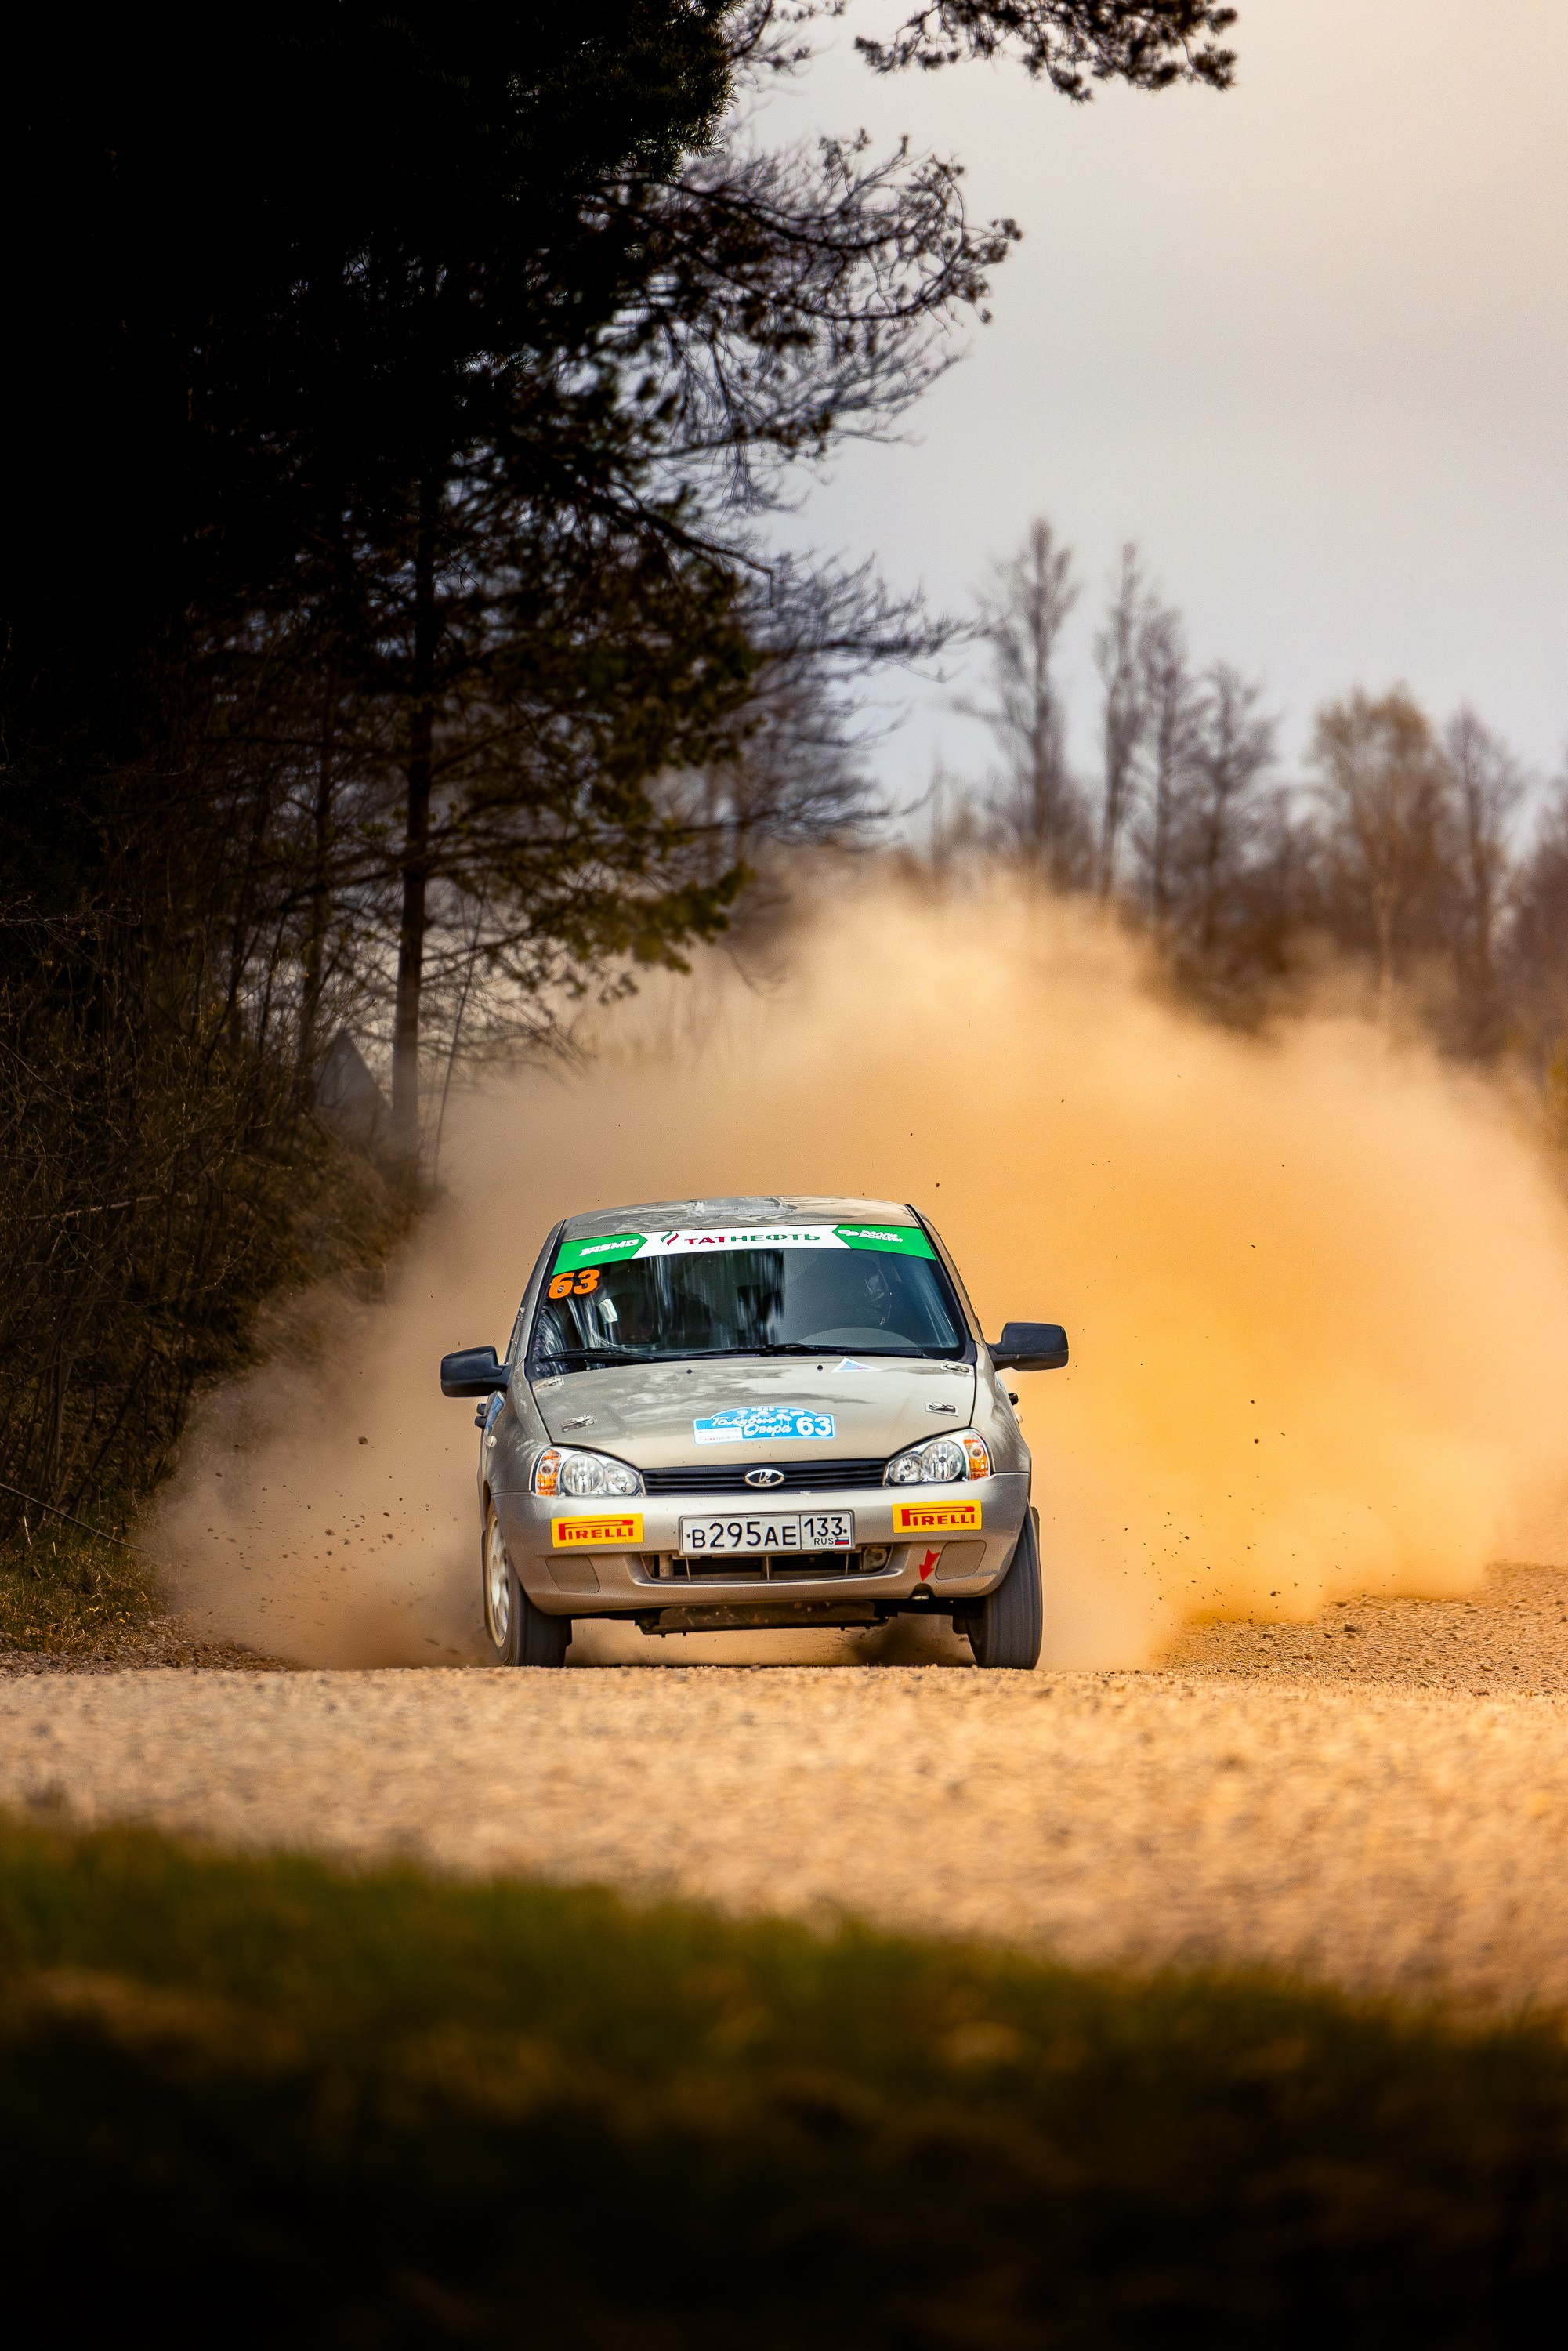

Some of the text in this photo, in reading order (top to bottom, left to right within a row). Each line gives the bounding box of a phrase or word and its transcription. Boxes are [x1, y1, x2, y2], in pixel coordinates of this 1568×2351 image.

[684, 1233, 820, 1245] ТАТНЕФТЬ
[549, 1269, 600, 1299] 63
[796, 1417, 832, 1436] 63
[901, 1506, 975, 1527] PIRELLI
[558, 1520, 634, 1541] PIRELLI
[804, 1517, 842, 1537] 133
[813, 1537, 835, 1545] RUS
